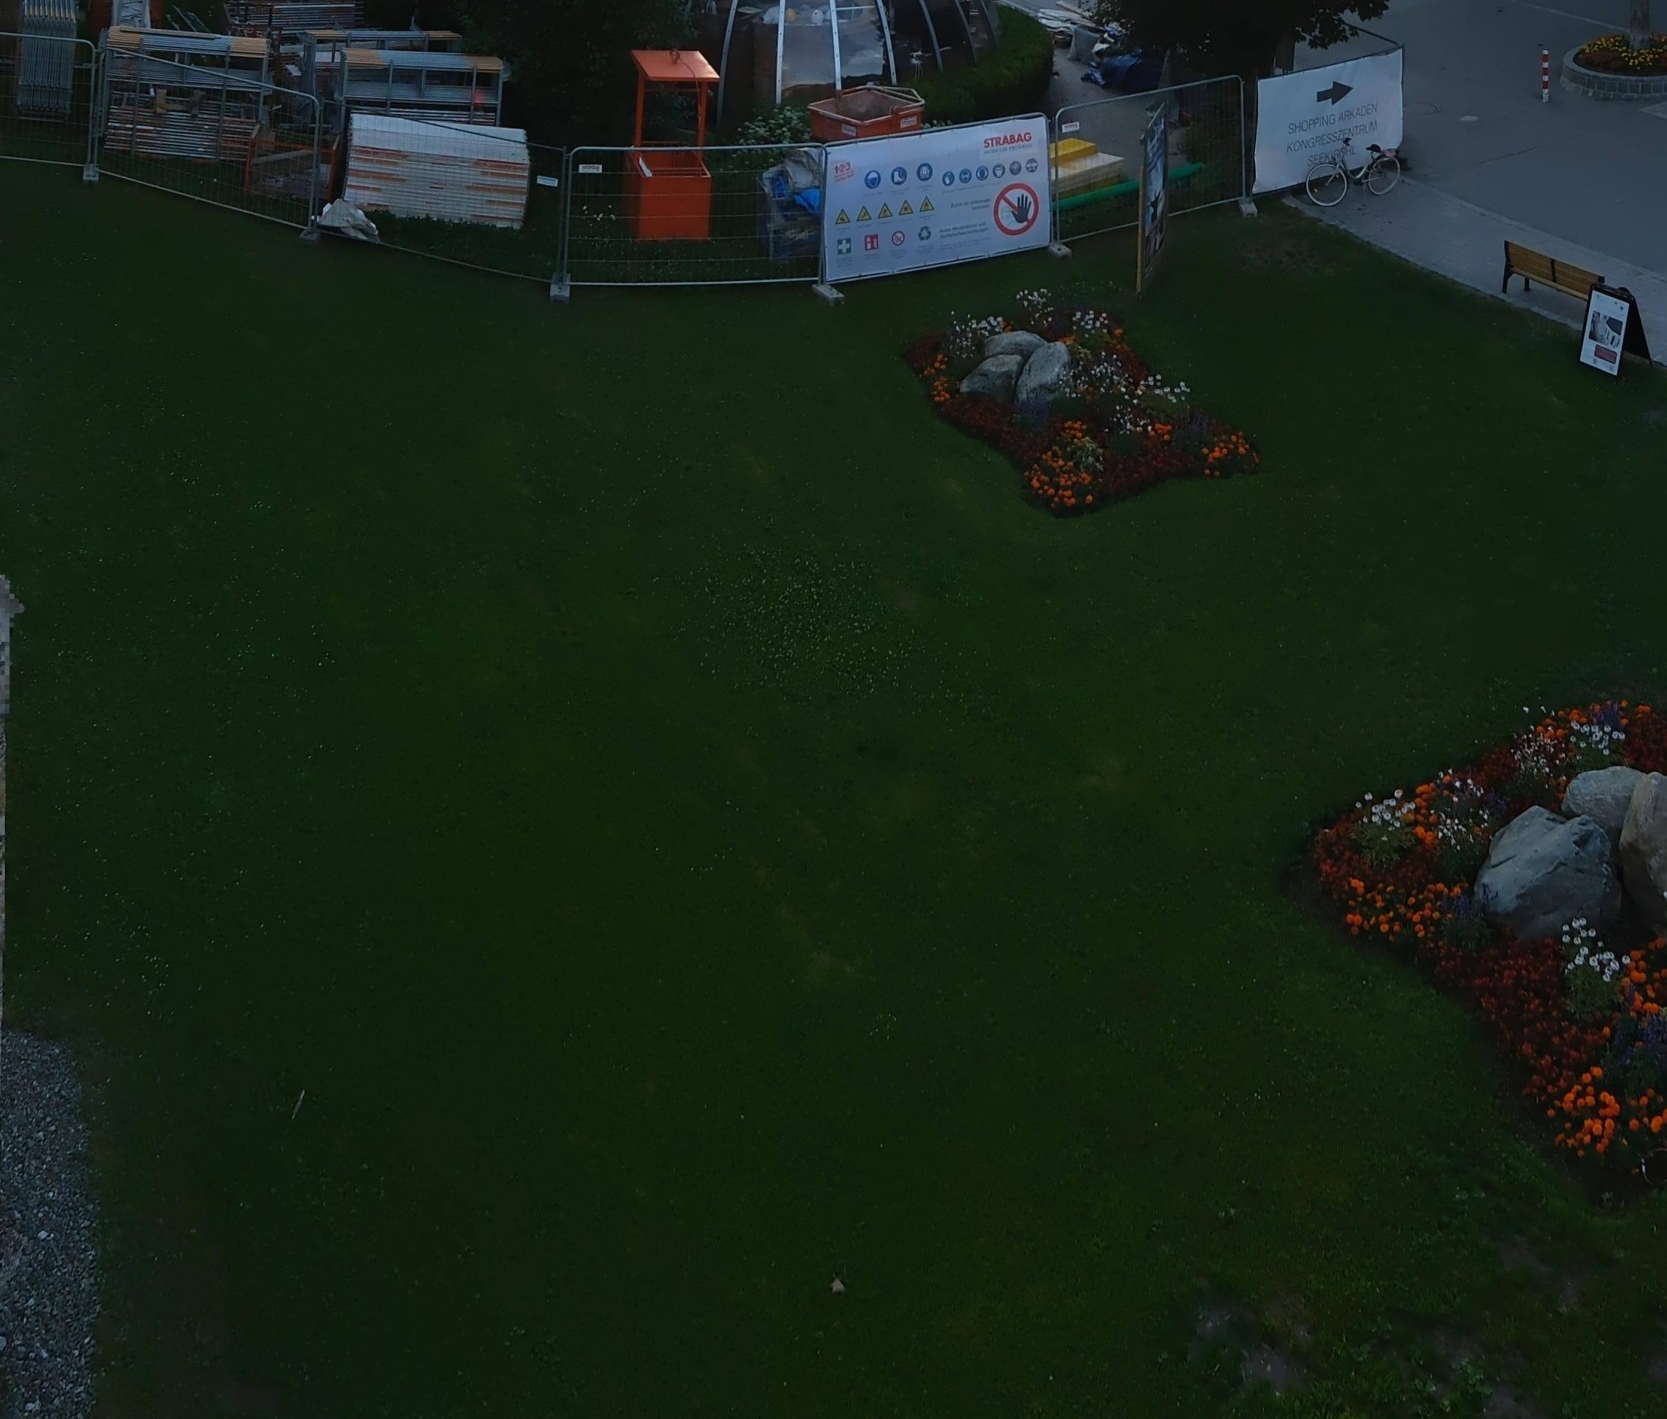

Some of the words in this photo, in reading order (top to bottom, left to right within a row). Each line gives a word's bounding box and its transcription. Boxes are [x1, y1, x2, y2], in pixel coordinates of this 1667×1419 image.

[1288, 114, 1336, 135] SHOPPING
[1338, 103, 1378, 121] ARKADEN
[983, 132, 1032, 149] STRABAG
[1286, 121, 1377, 153] KONGRESSZENTRUM
